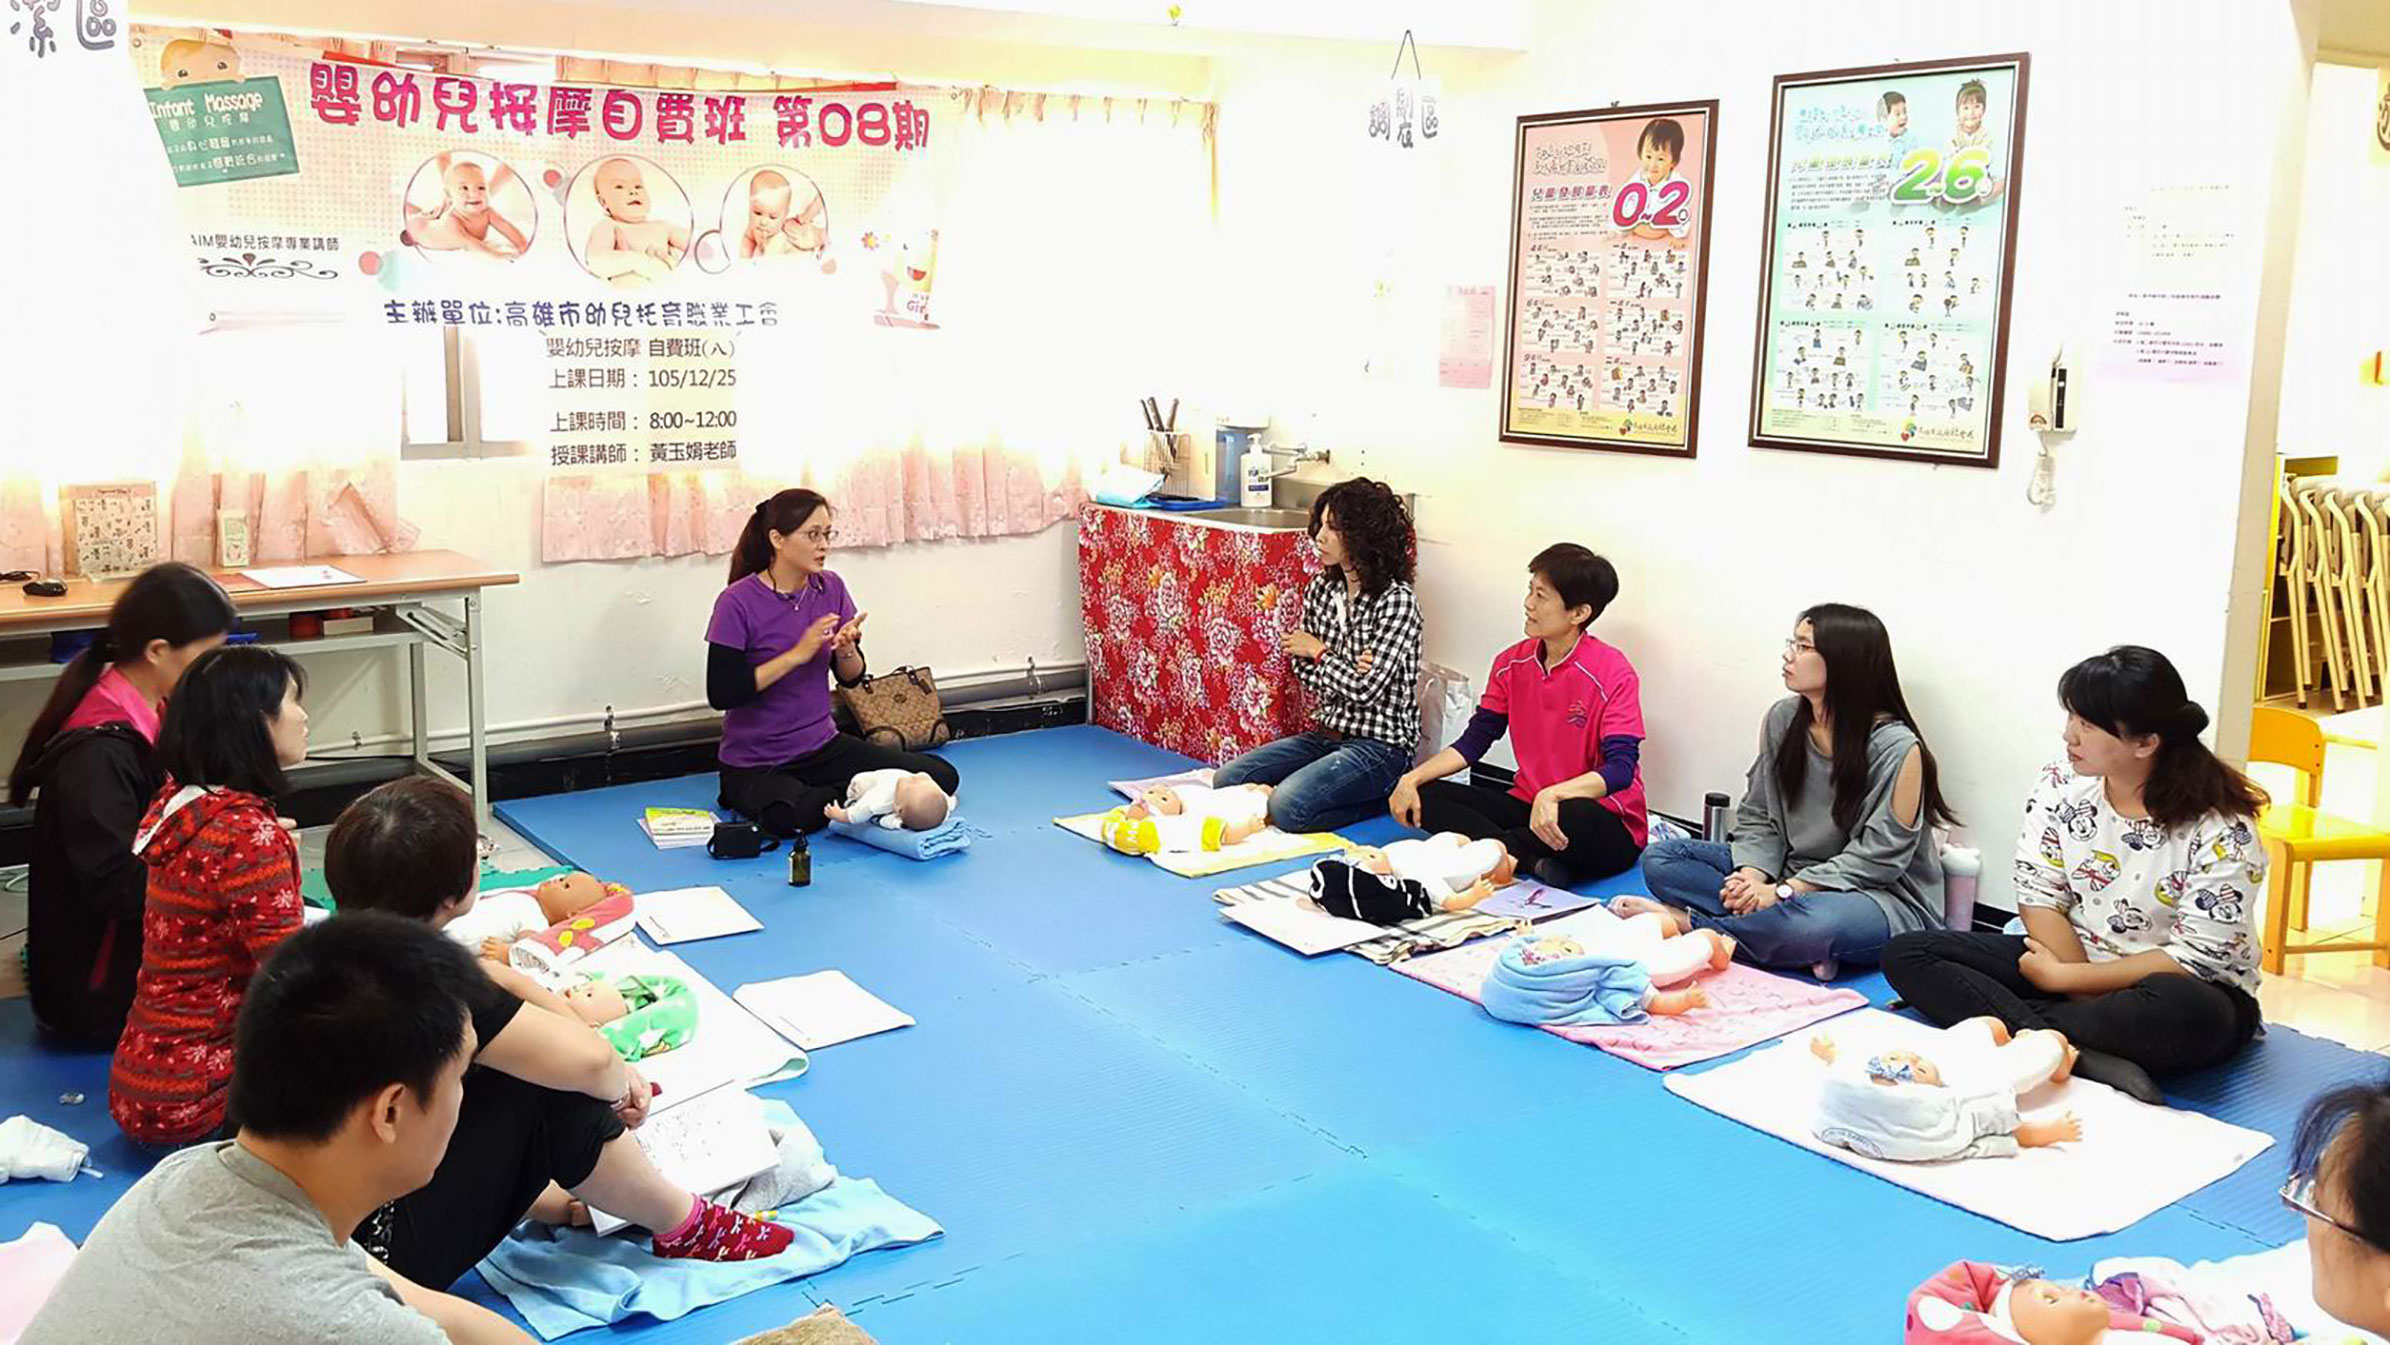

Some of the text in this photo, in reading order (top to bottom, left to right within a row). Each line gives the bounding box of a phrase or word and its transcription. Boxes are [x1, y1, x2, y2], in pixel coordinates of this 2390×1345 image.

[149, 91, 263, 119] Infant Massage
[309, 63, 931, 152] 嬰幼兒按摩自費班 第08期
[546, 337, 736, 359] 嬰幼兒按摩 自費班(八)
[649, 368, 737, 389] 105/12/25
[649, 410, 738, 430] 8:00~12:00
[649, 440, 737, 463] 黃玉娟老師
